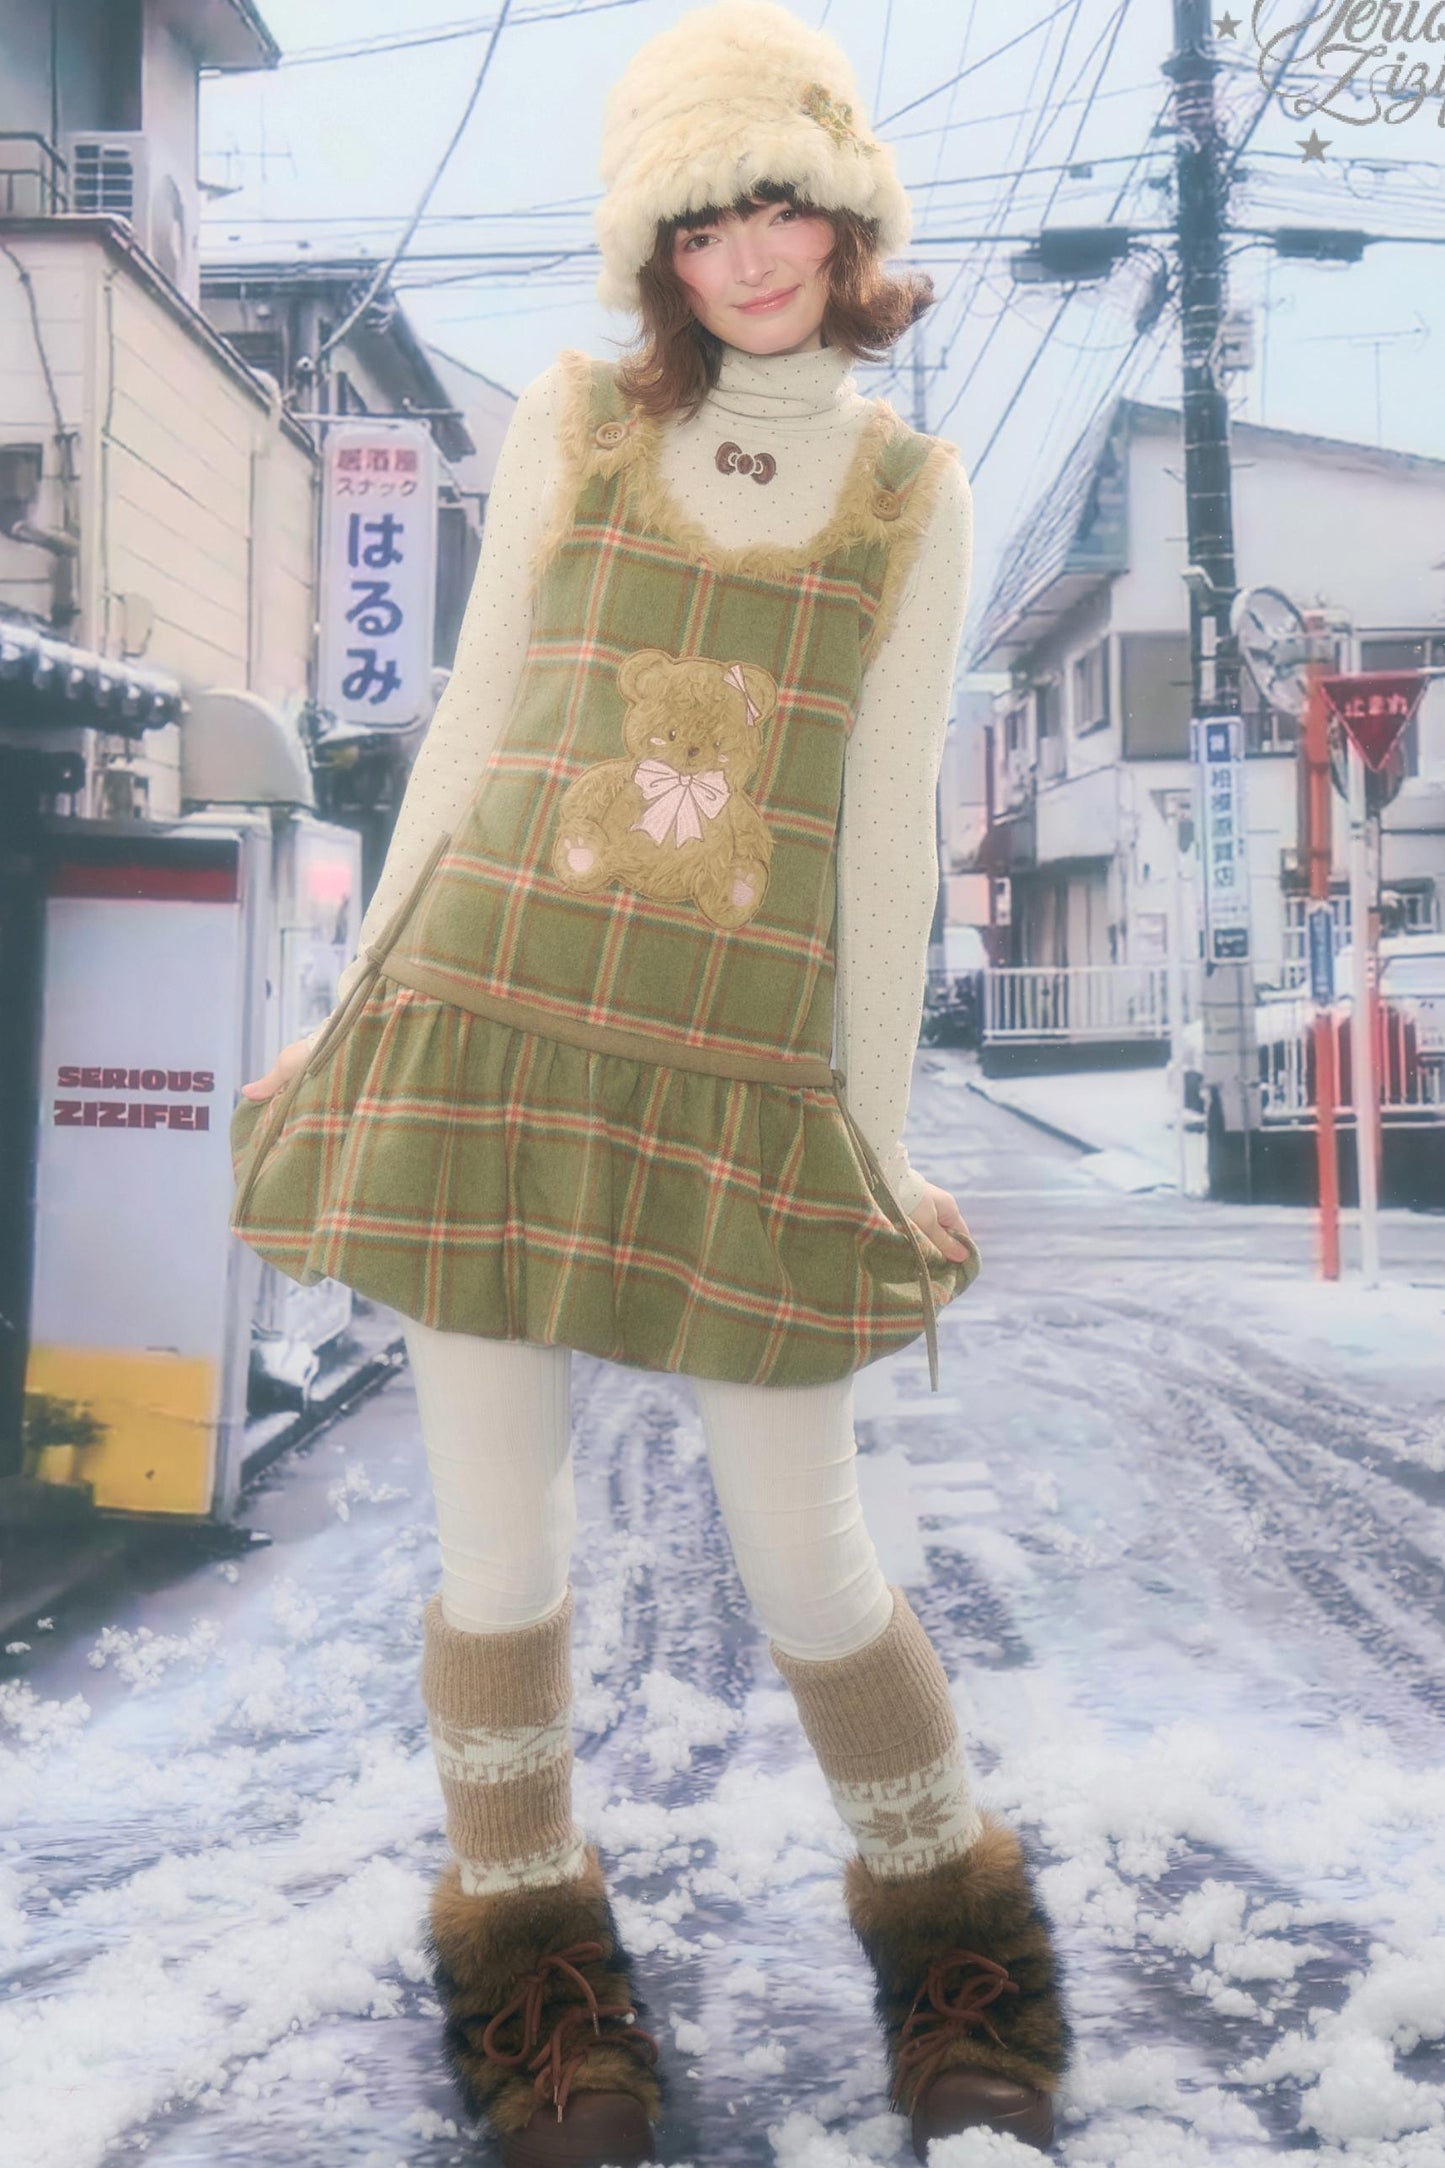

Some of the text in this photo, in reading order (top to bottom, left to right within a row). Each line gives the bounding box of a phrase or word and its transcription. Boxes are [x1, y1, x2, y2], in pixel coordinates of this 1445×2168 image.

[337, 477, 418, 497] スナック
[341, 513, 404, 705] はるみ
[1344, 693, 1408, 717] 止まれ
[57, 1065, 215, 1093] SERIOUS
